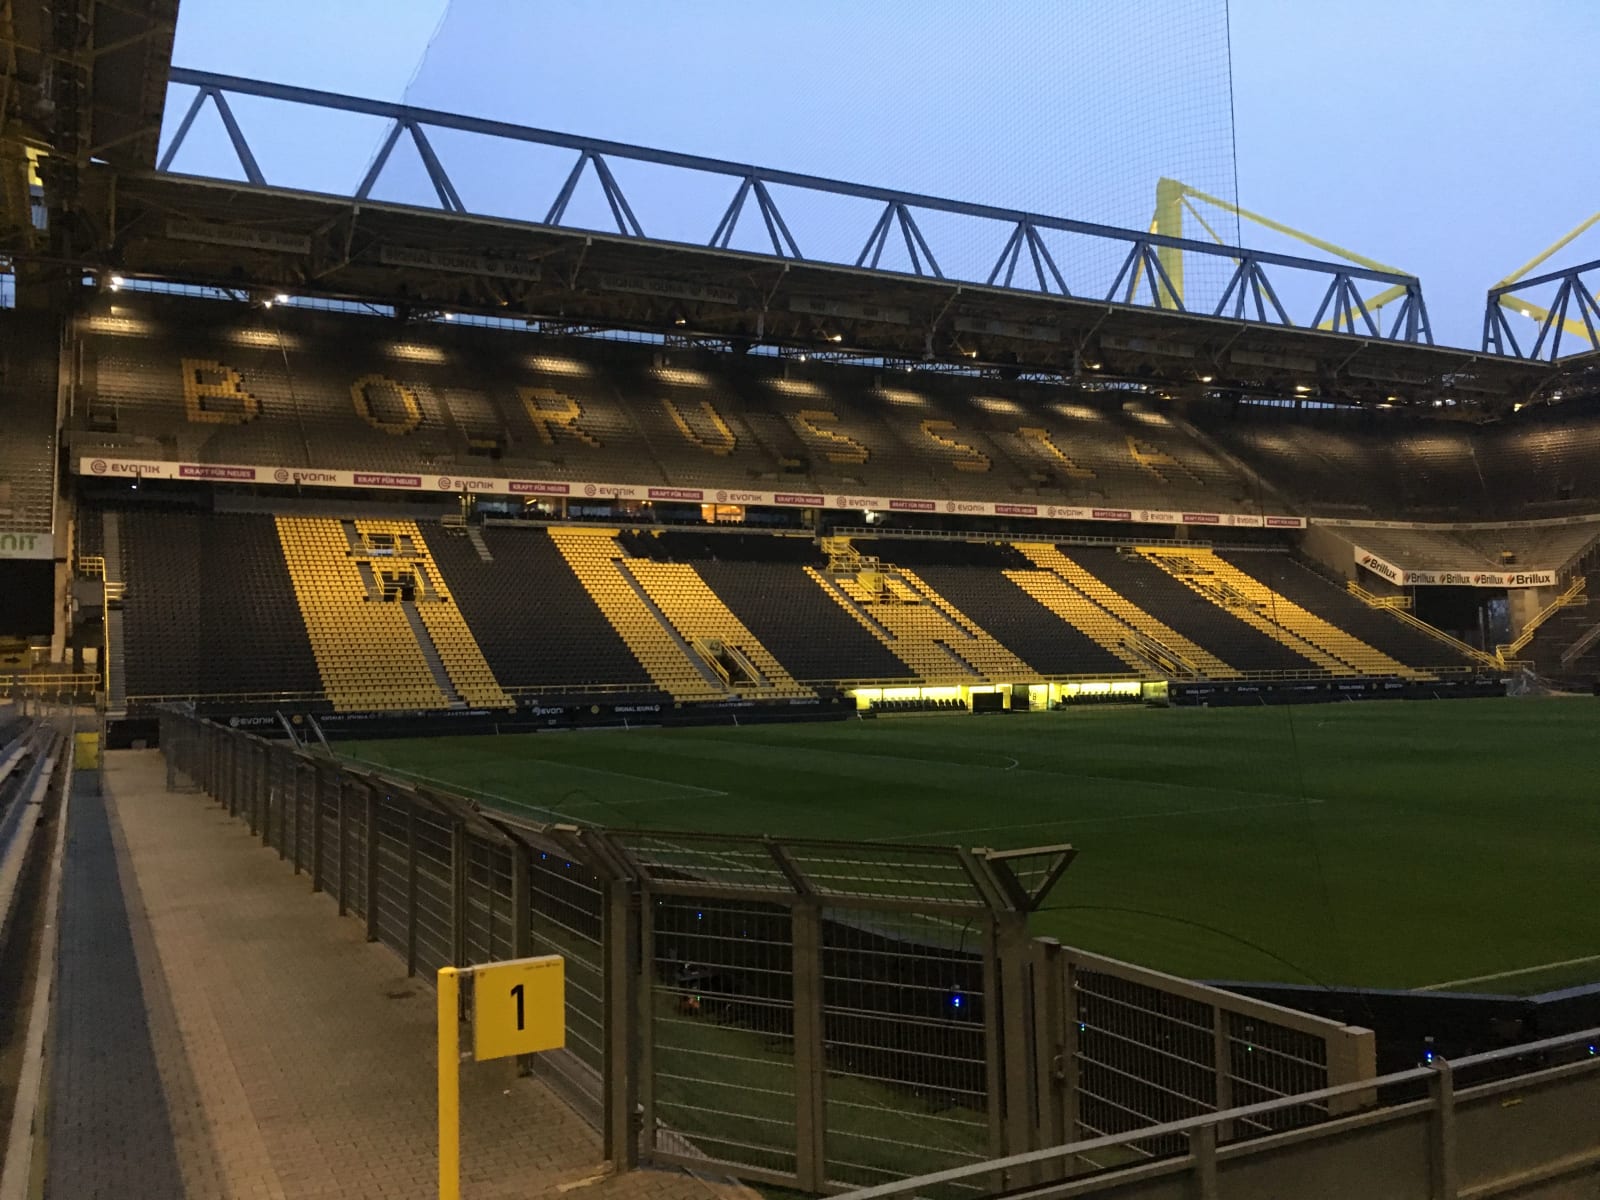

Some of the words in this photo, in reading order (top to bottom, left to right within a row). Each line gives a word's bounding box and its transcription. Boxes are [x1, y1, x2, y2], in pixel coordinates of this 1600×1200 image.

[111, 463, 161, 474] EVONIK
[183, 468, 209, 476] KRAFT
[226, 469, 251, 478] NEUES
[293, 472, 337, 482] EVONIK
[357, 476, 381, 484] KRAFT
[454, 480, 494, 489] EVONIK
[599, 487, 635, 496] EVONIK
[730, 494, 762, 502] EVONIK
[848, 498, 878, 507] EVONIK
[1369, 559, 1397, 581] Brillux
[1410, 572, 1436, 584] Brillux
[1446, 573, 1471, 584] Brillux
[1480, 574, 1504, 585] Brillux
[1516, 574, 1551, 585] Brillux
[510, 983, 525, 1031] 1
